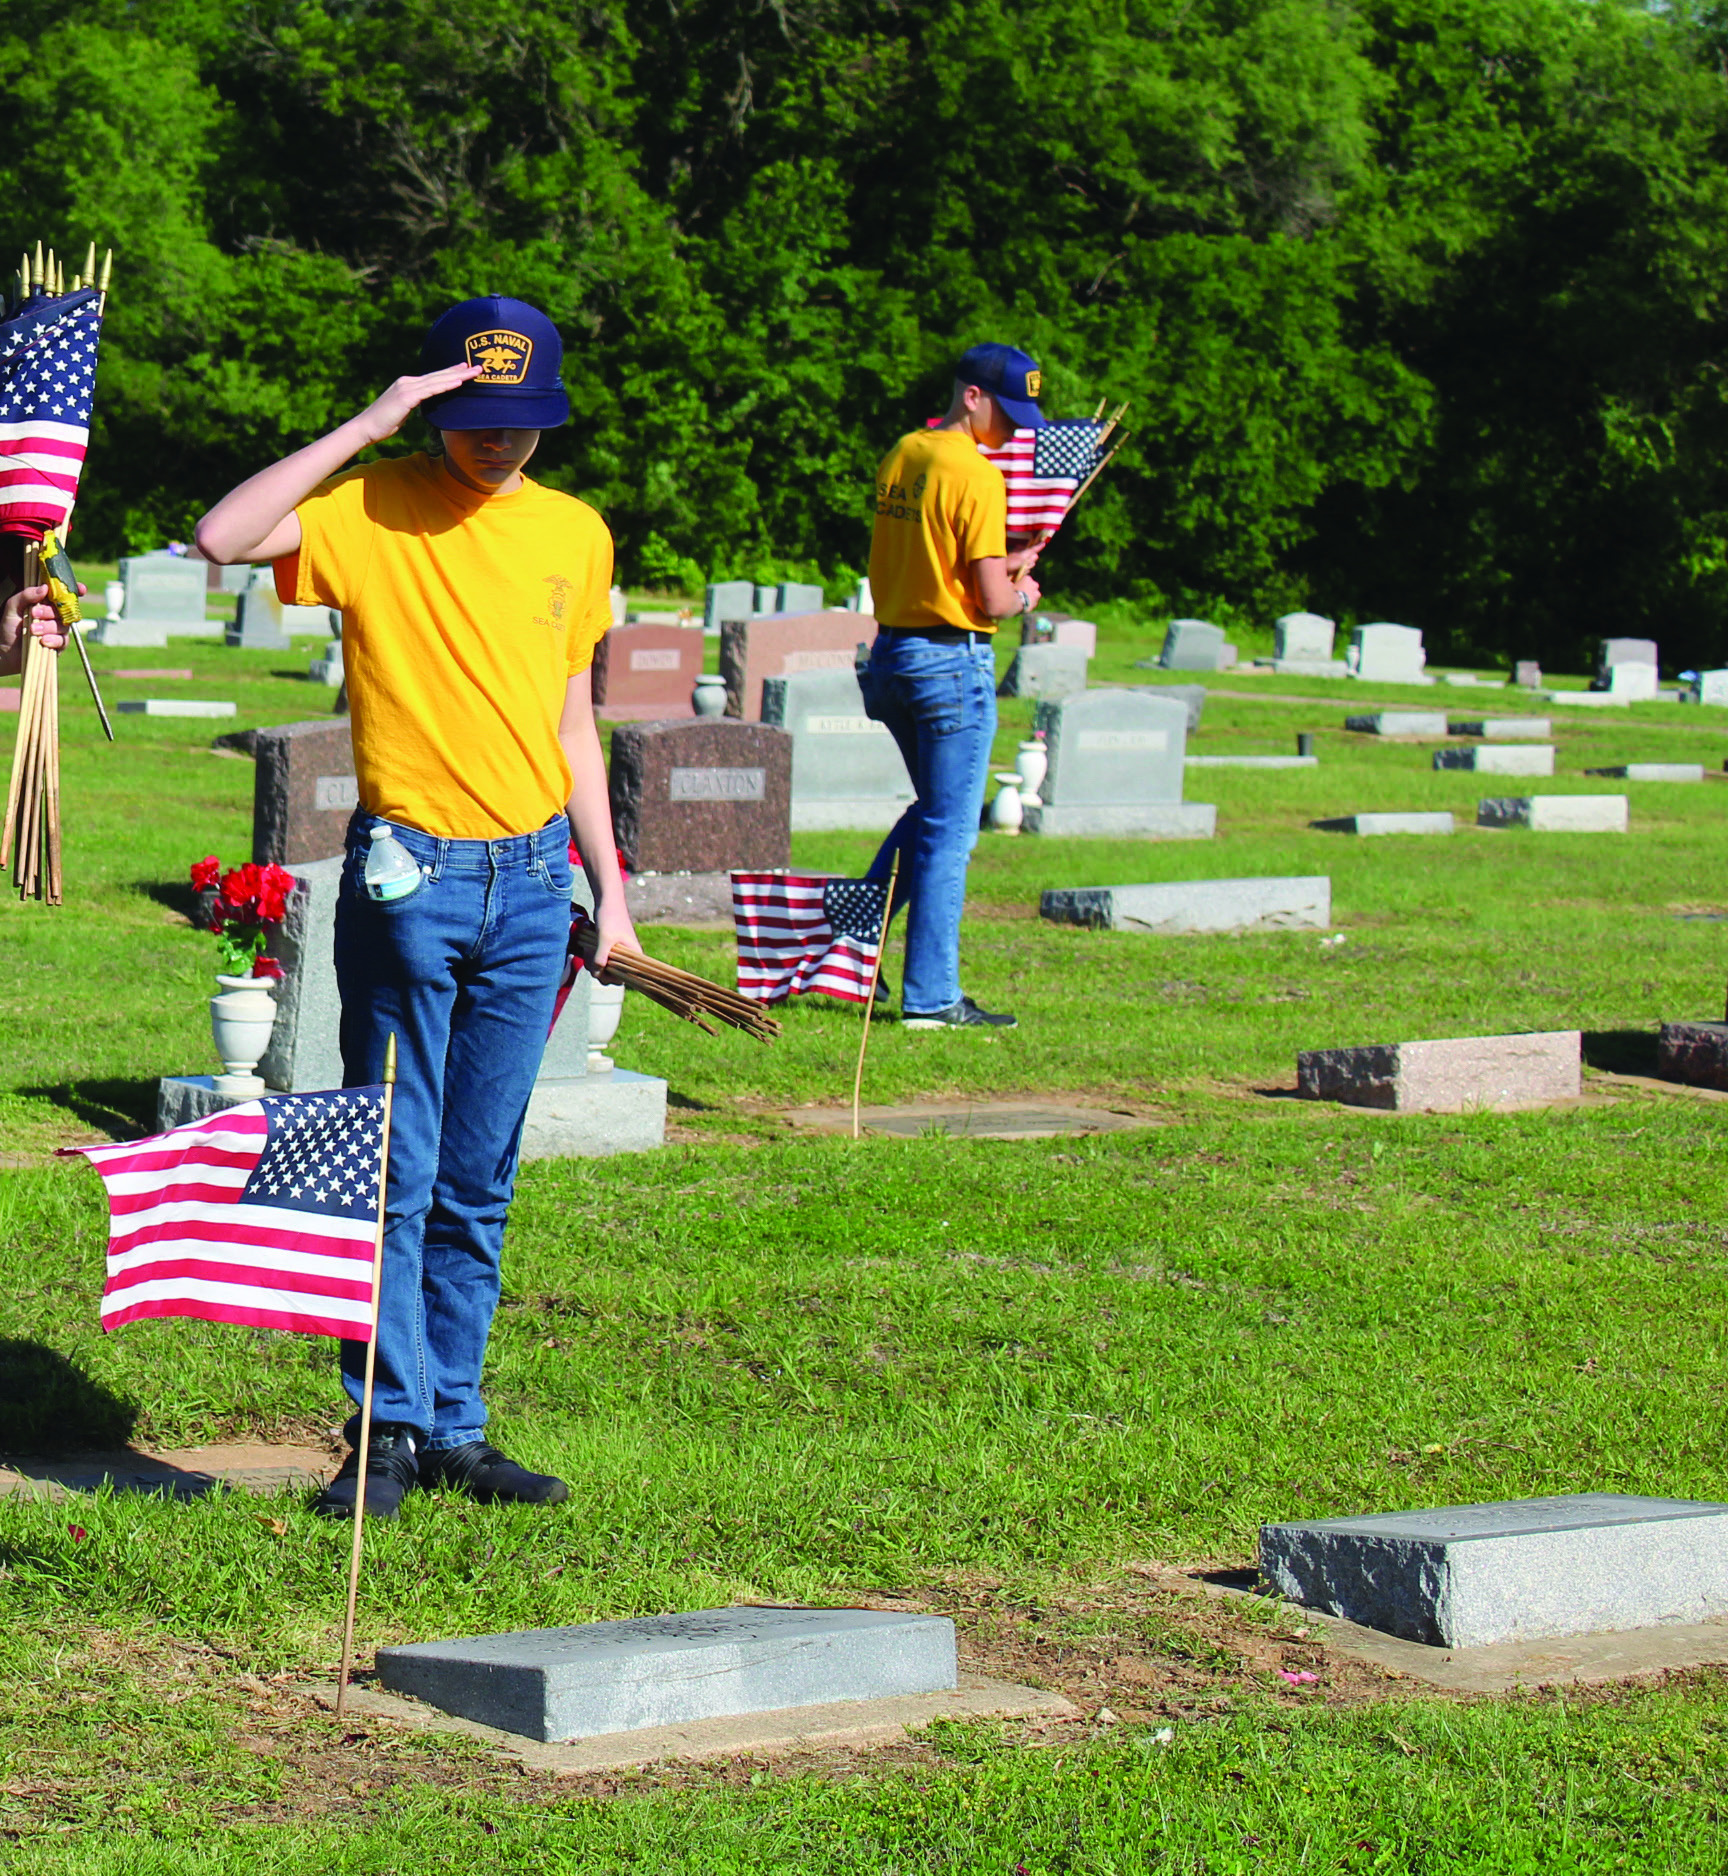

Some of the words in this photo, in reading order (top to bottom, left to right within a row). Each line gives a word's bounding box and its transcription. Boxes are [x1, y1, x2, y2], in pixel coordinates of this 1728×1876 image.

[469, 336, 491, 349] U.S.
[494, 334, 526, 352] NAVAL
[879, 483, 907, 501] SEA
[532, 616, 550, 627] SEA
